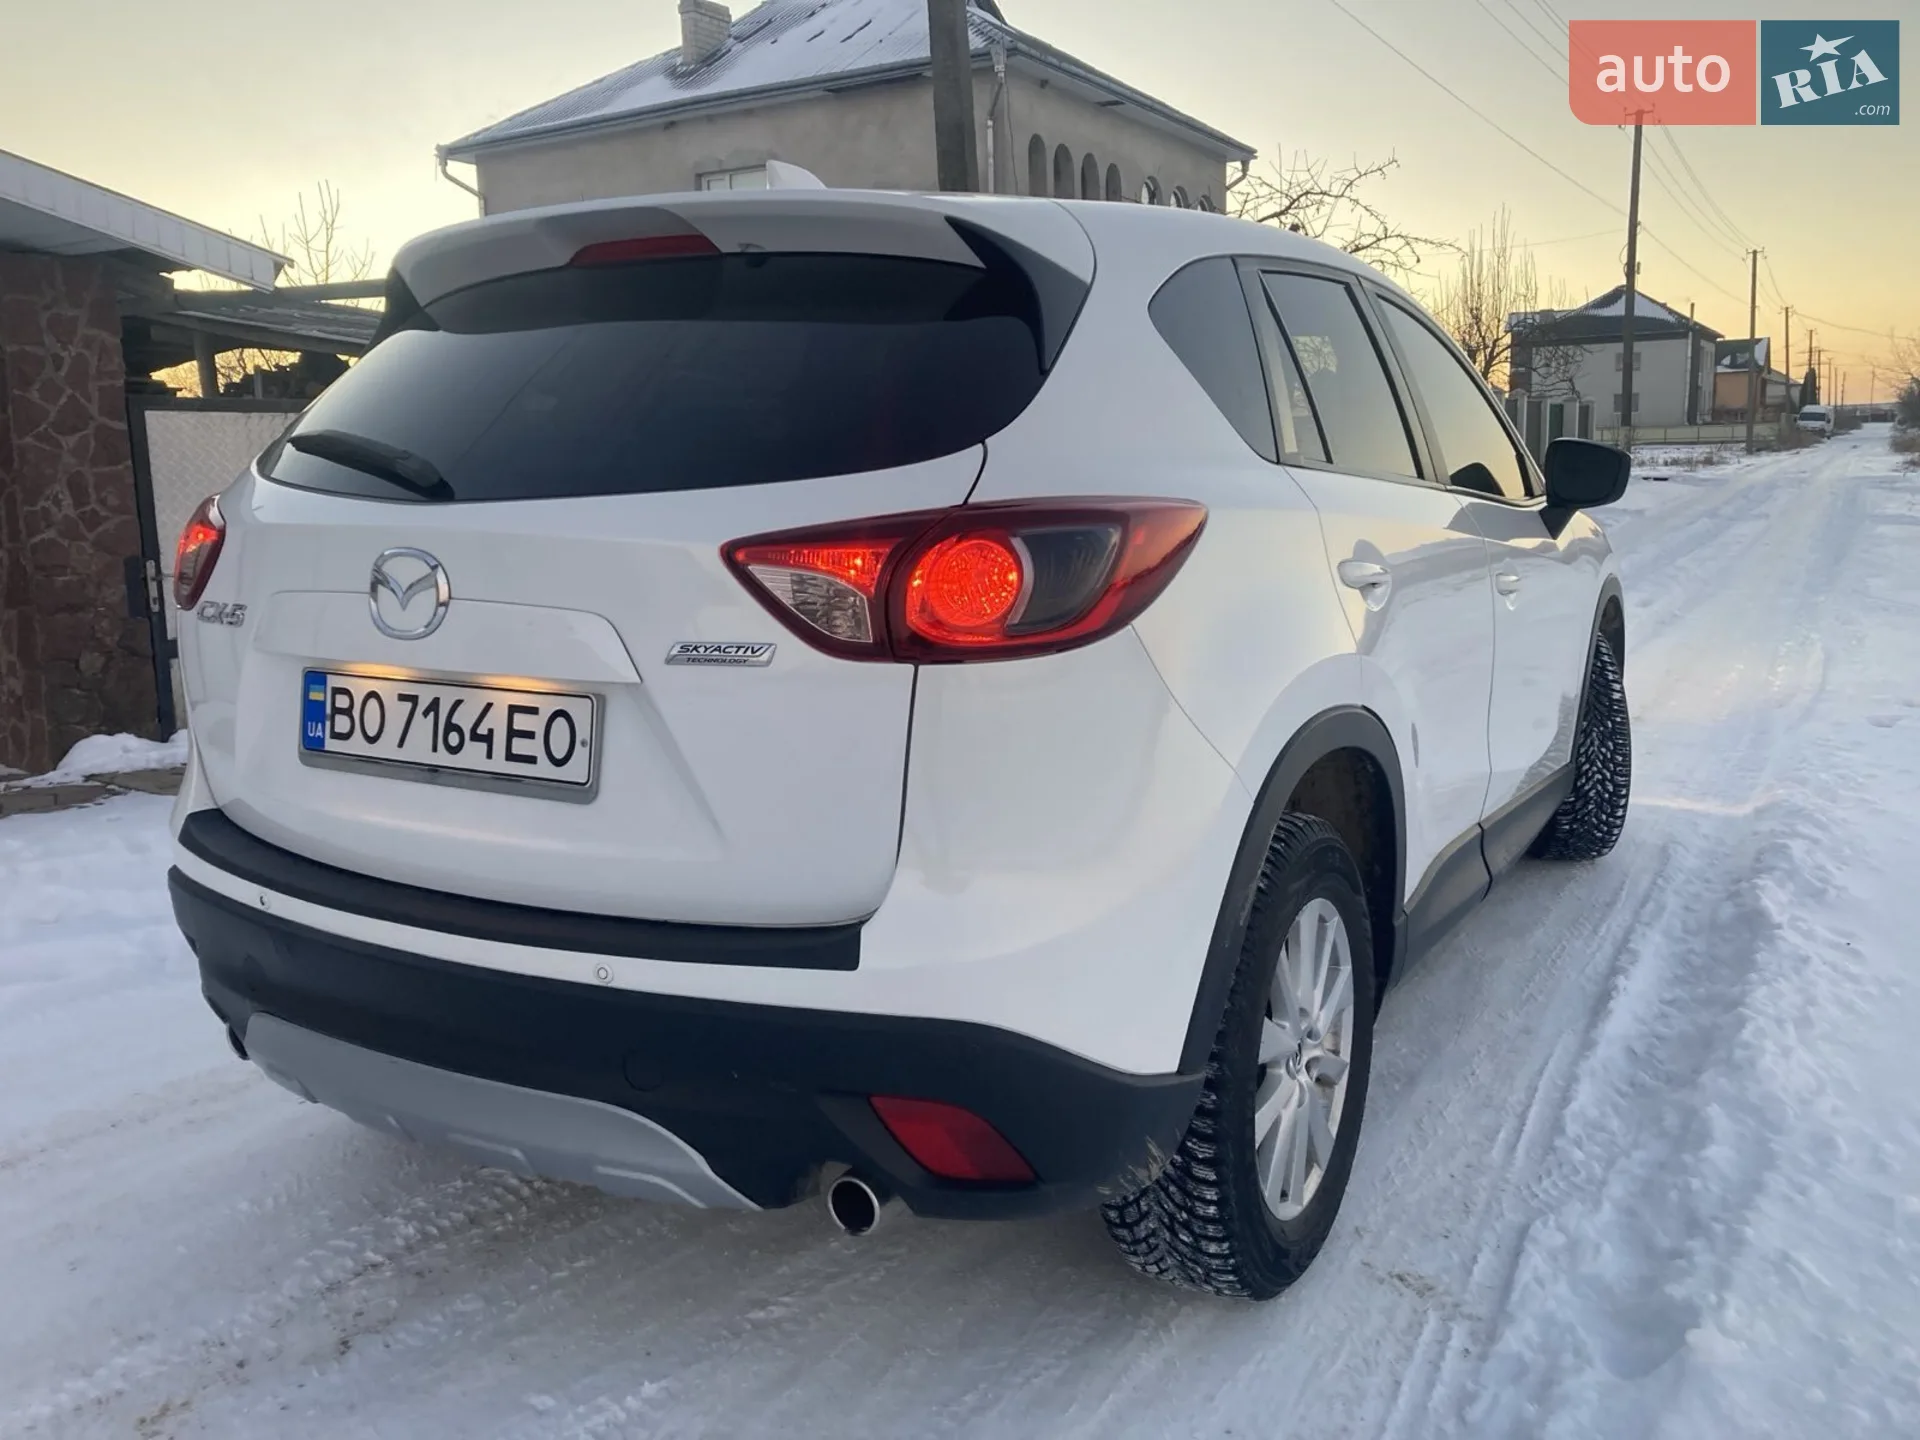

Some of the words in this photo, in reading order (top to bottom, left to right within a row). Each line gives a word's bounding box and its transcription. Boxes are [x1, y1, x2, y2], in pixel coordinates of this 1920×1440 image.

[677, 644, 764, 655] SKYACTIV
[686, 657, 749, 665] TECHNOLOGY
[307, 721, 324, 739] UA
[396, 692, 494, 760] 7164
